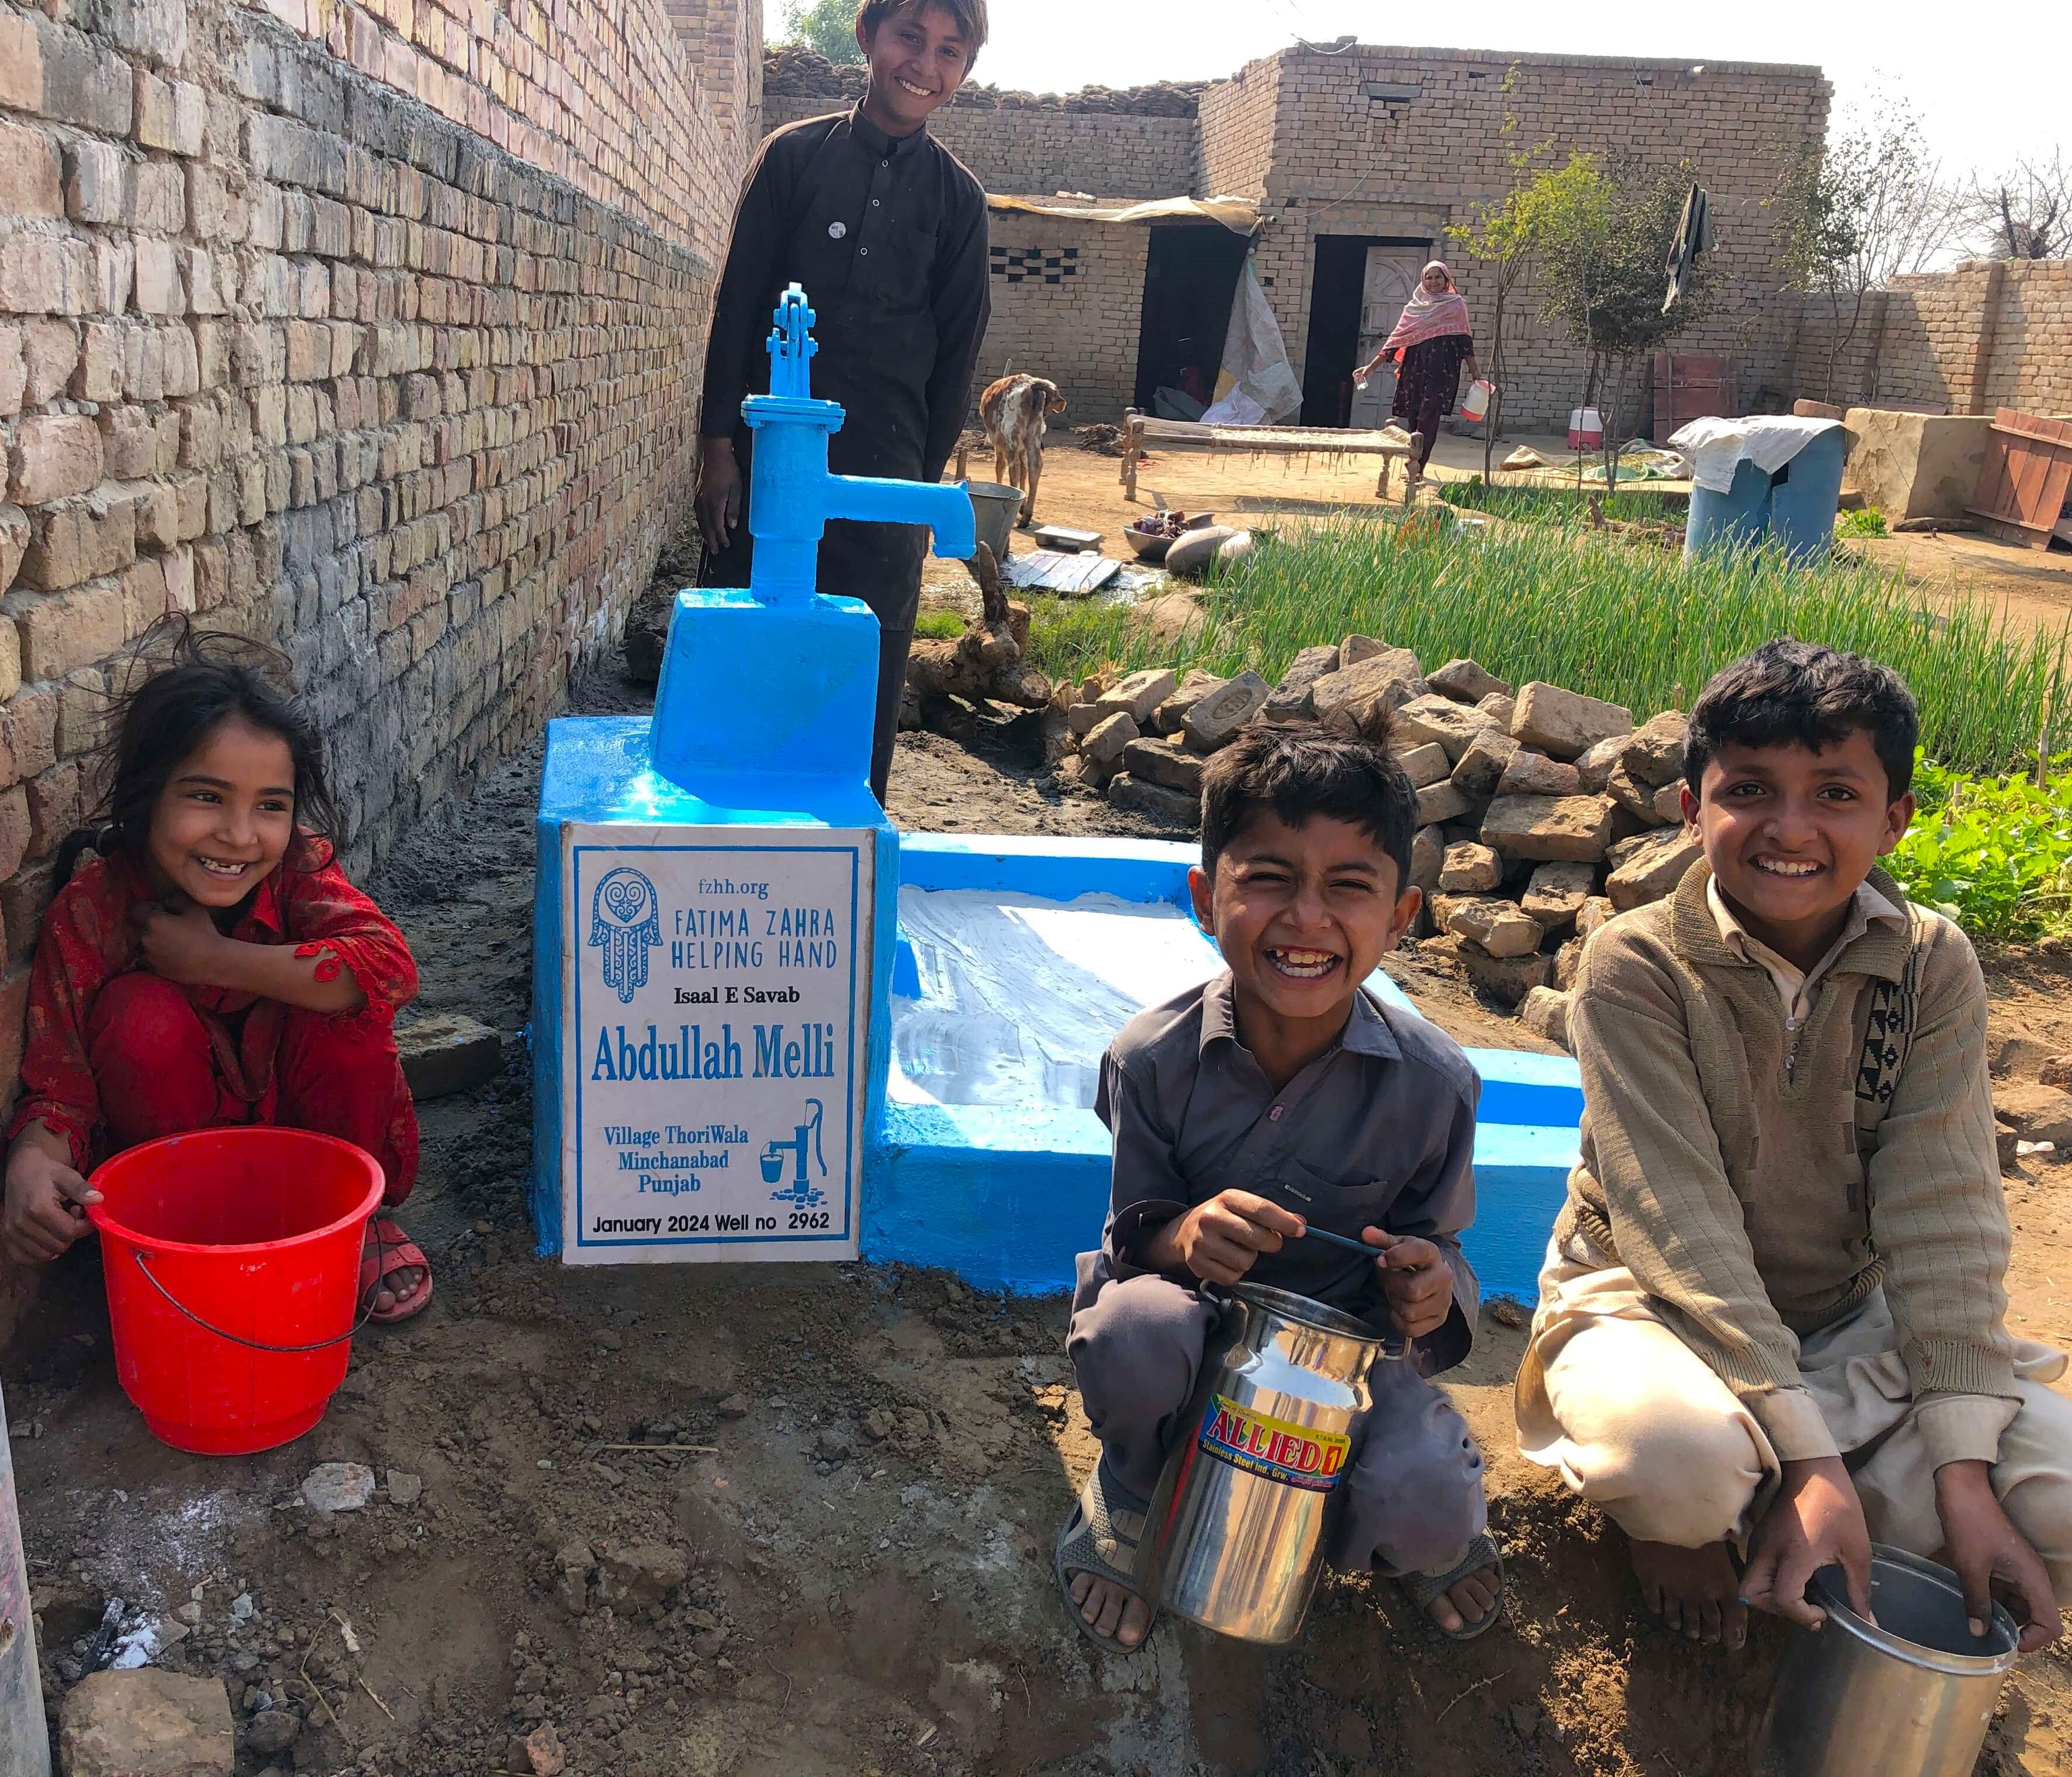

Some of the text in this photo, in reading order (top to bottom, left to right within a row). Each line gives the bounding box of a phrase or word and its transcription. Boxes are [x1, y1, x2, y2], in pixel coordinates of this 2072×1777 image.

[698, 878, 770, 900] fzhh.org
[675, 908, 834, 939] FATIMA ZAHRA
[671, 939, 837, 970] HELPING HAND
[674, 985, 800, 1004] Isaal E Savab
[592, 1023, 835, 1082] Abdullah Melli
[604, 1124, 749, 1148] Village ThoriWala
[618, 1150, 728, 1170] Minchanabad
[638, 1173, 701, 1197] Punjab
[592, 1212, 830, 1235] January 2024 Well no 2962
[1207, 1409, 1322, 1473] ALLIED
[1203, 1439, 1232, 1461] Stainless
[1234, 1453, 1253, 1469] Steel
[1255, 1461, 1269, 1475] Ind.
[1272, 1467, 1288, 1481] Grw.
